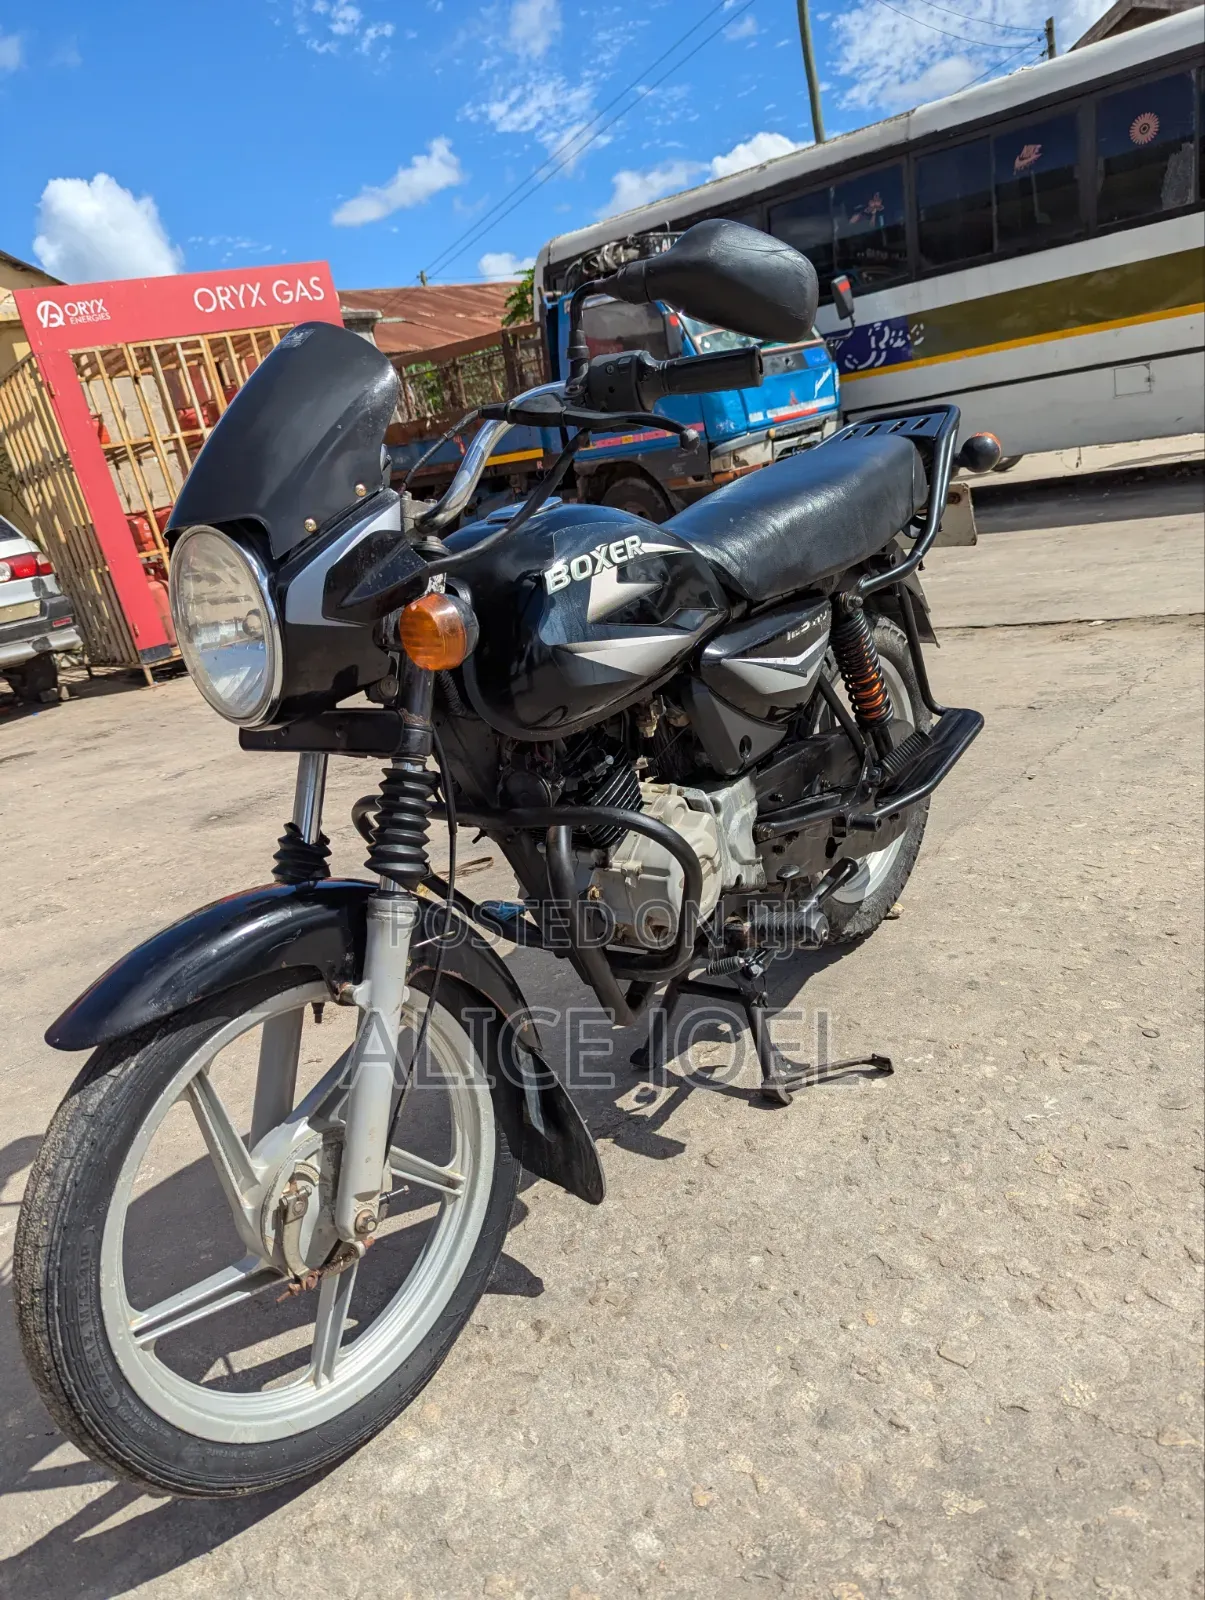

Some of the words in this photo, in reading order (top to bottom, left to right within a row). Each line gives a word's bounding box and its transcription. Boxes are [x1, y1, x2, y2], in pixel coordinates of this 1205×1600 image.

[64, 298, 108, 317] ORYX
[193, 281, 267, 313] ORYX
[272, 276, 325, 304] GAS
[69, 311, 111, 325] ENERGIES
[543, 534, 645, 596] BOXER
